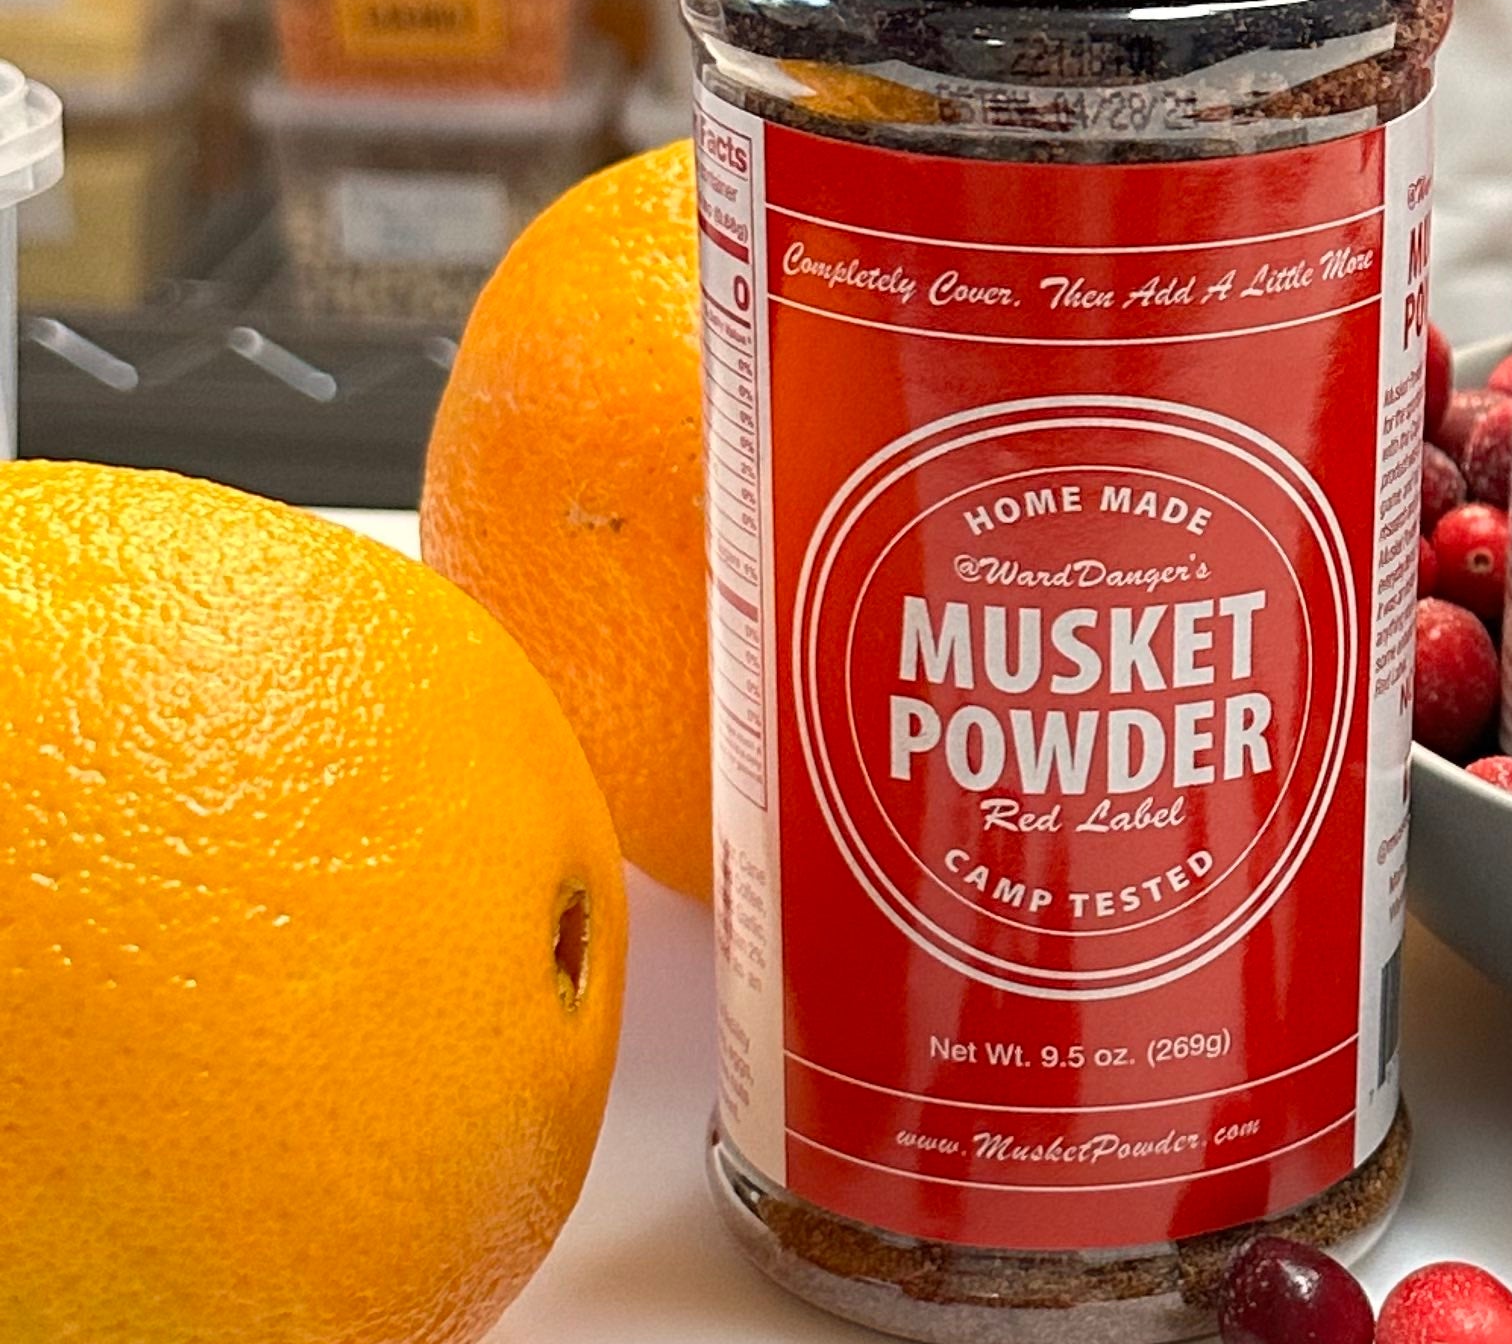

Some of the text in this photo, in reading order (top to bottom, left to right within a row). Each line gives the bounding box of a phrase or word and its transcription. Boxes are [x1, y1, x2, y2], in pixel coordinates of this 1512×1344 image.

[733, 274, 750, 312] 0
[782, 240, 1374, 310] Completely Cover. Then Add A Little More
[963, 485, 1213, 536] HOME MADE
[953, 552, 1212, 593] @WardDanger's
[898, 589, 1267, 695] MUSKET
[889, 691, 1273, 795] POWDER
[979, 795, 1186, 833] Red Label
[944, 848, 1214, 918] CAMP TESTED
[929, 1027, 1232, 1069] Net Wt. 9.5 oz. (269g)
[895, 1118, 1261, 1164] www.MusketPowder.com
